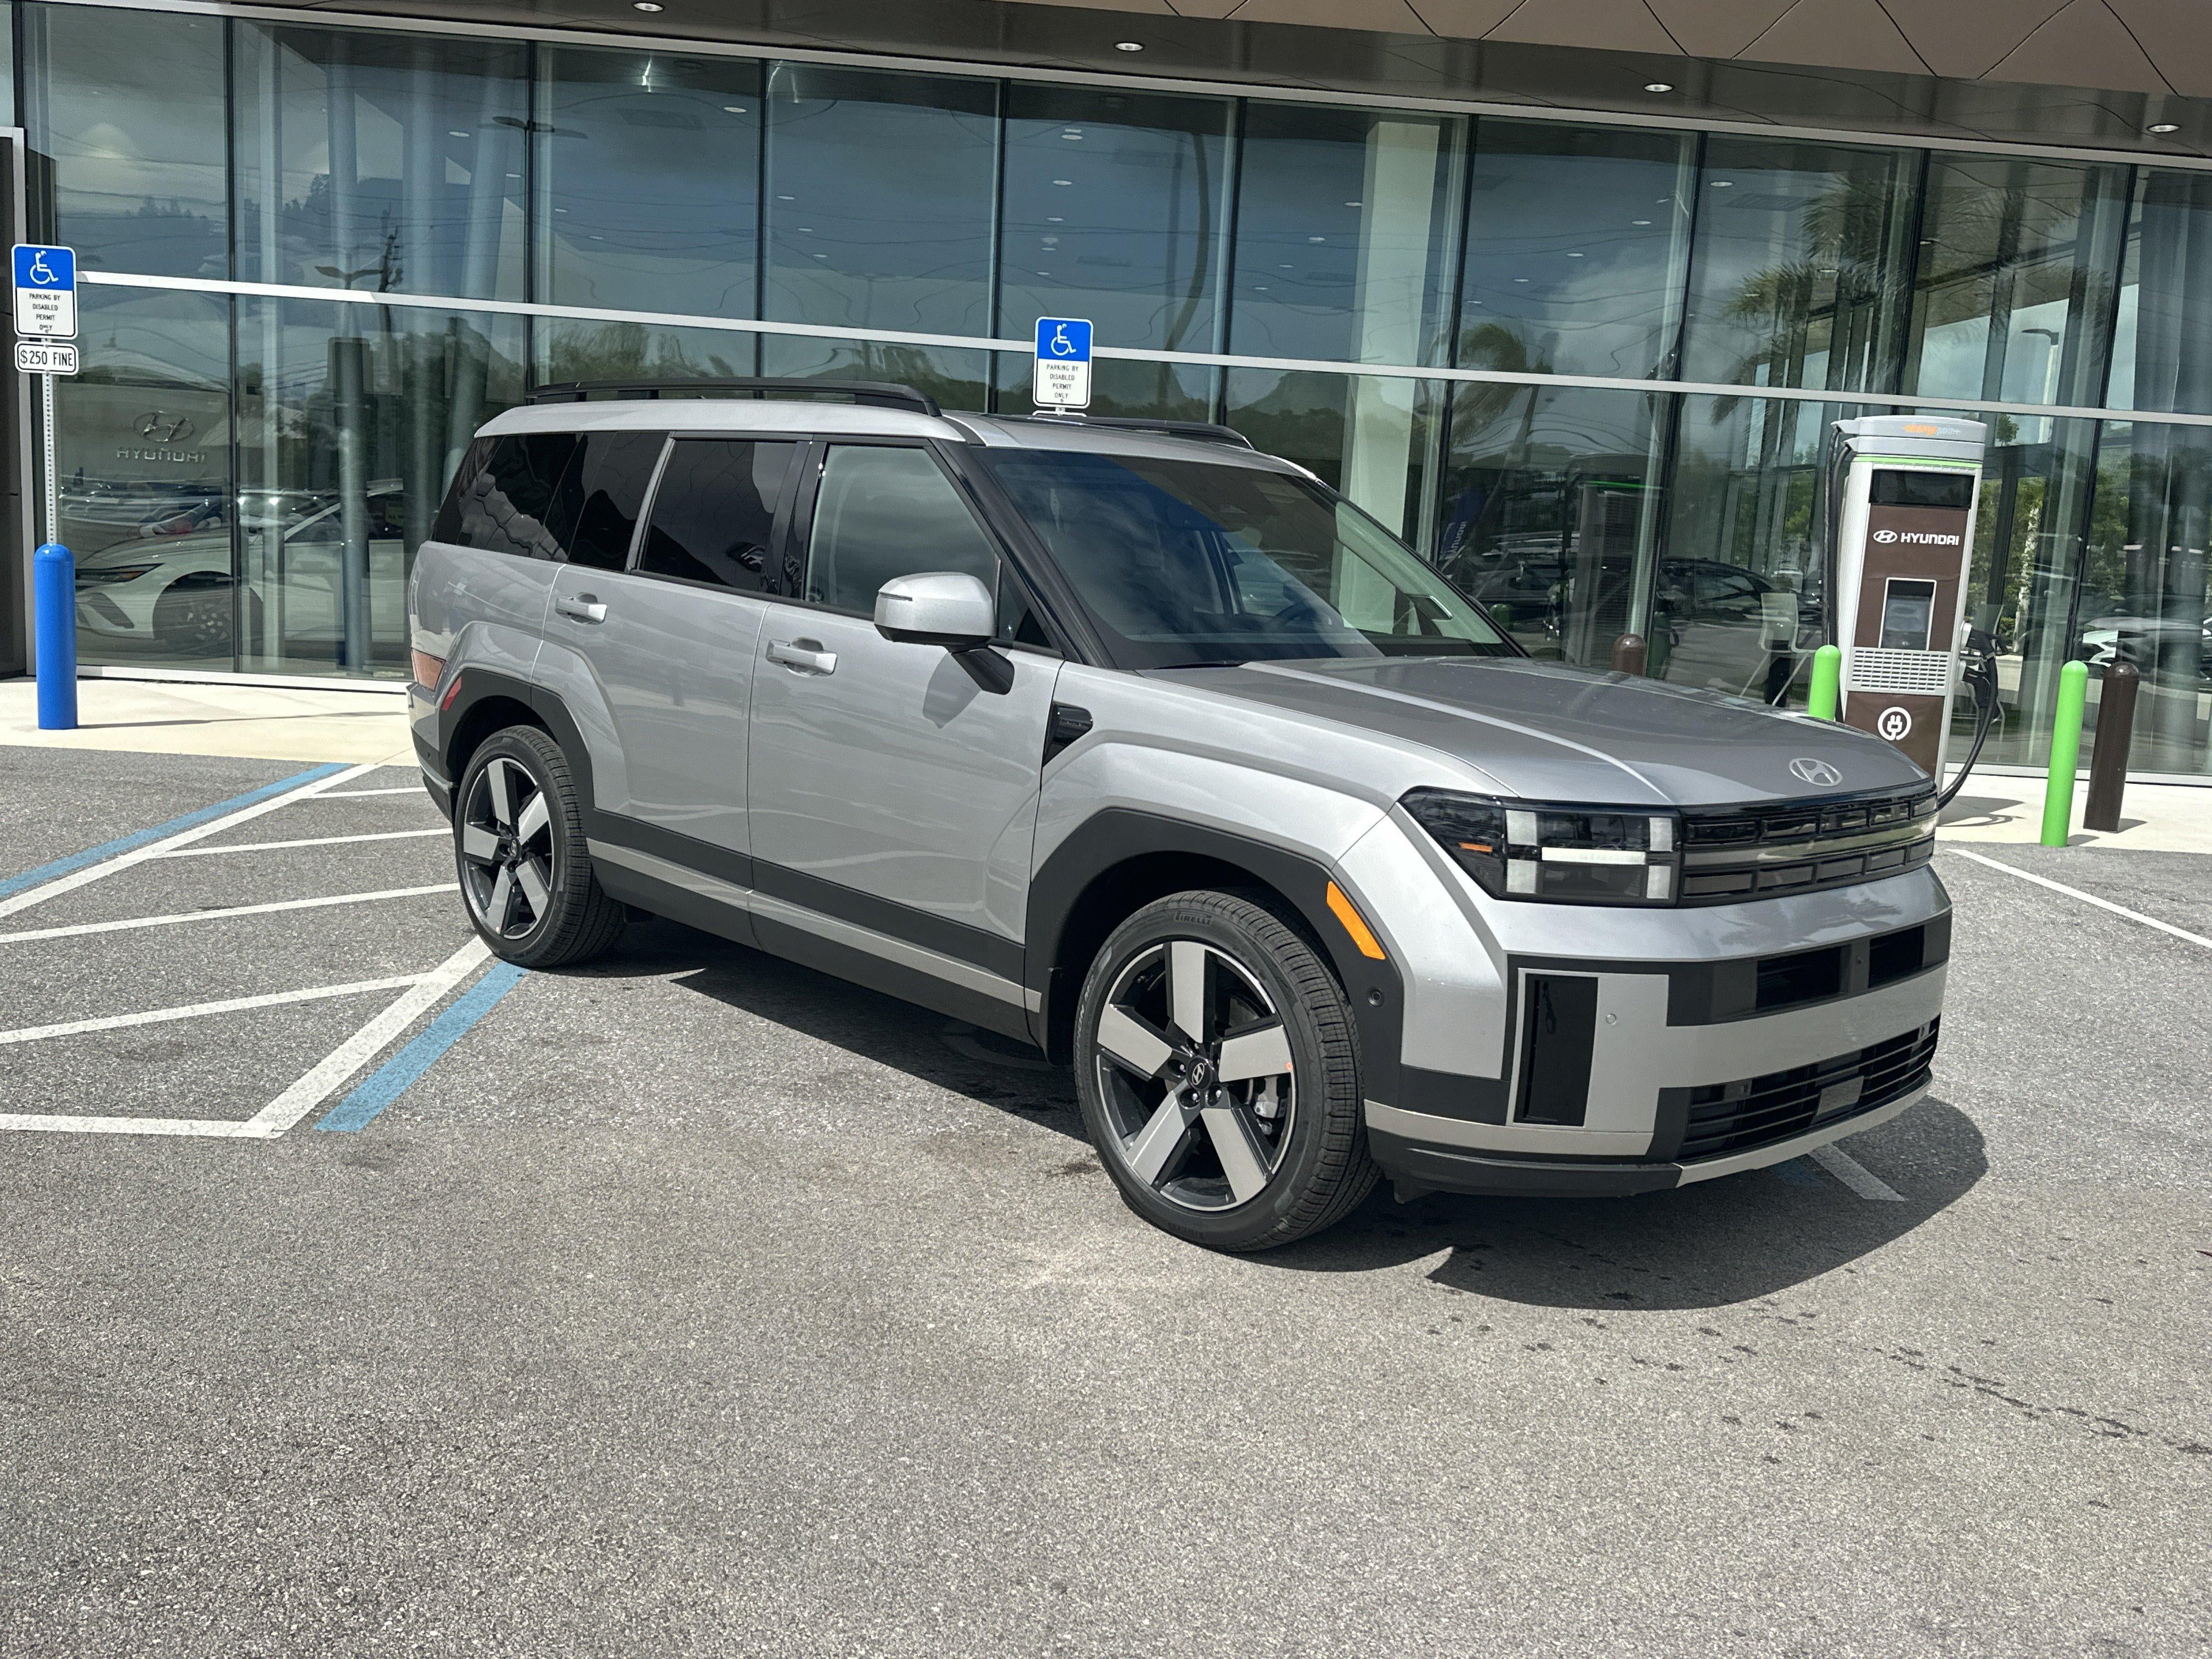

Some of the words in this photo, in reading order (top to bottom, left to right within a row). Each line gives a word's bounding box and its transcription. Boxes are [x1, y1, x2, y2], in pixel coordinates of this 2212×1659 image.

[20, 349, 48, 365] $250
[53, 352, 73, 366] FINE
[116, 447, 206, 463] HYUNDAI
[1900, 532, 1960, 546] HYUNDAI
[1175, 910, 1212, 926] PIRELLI
